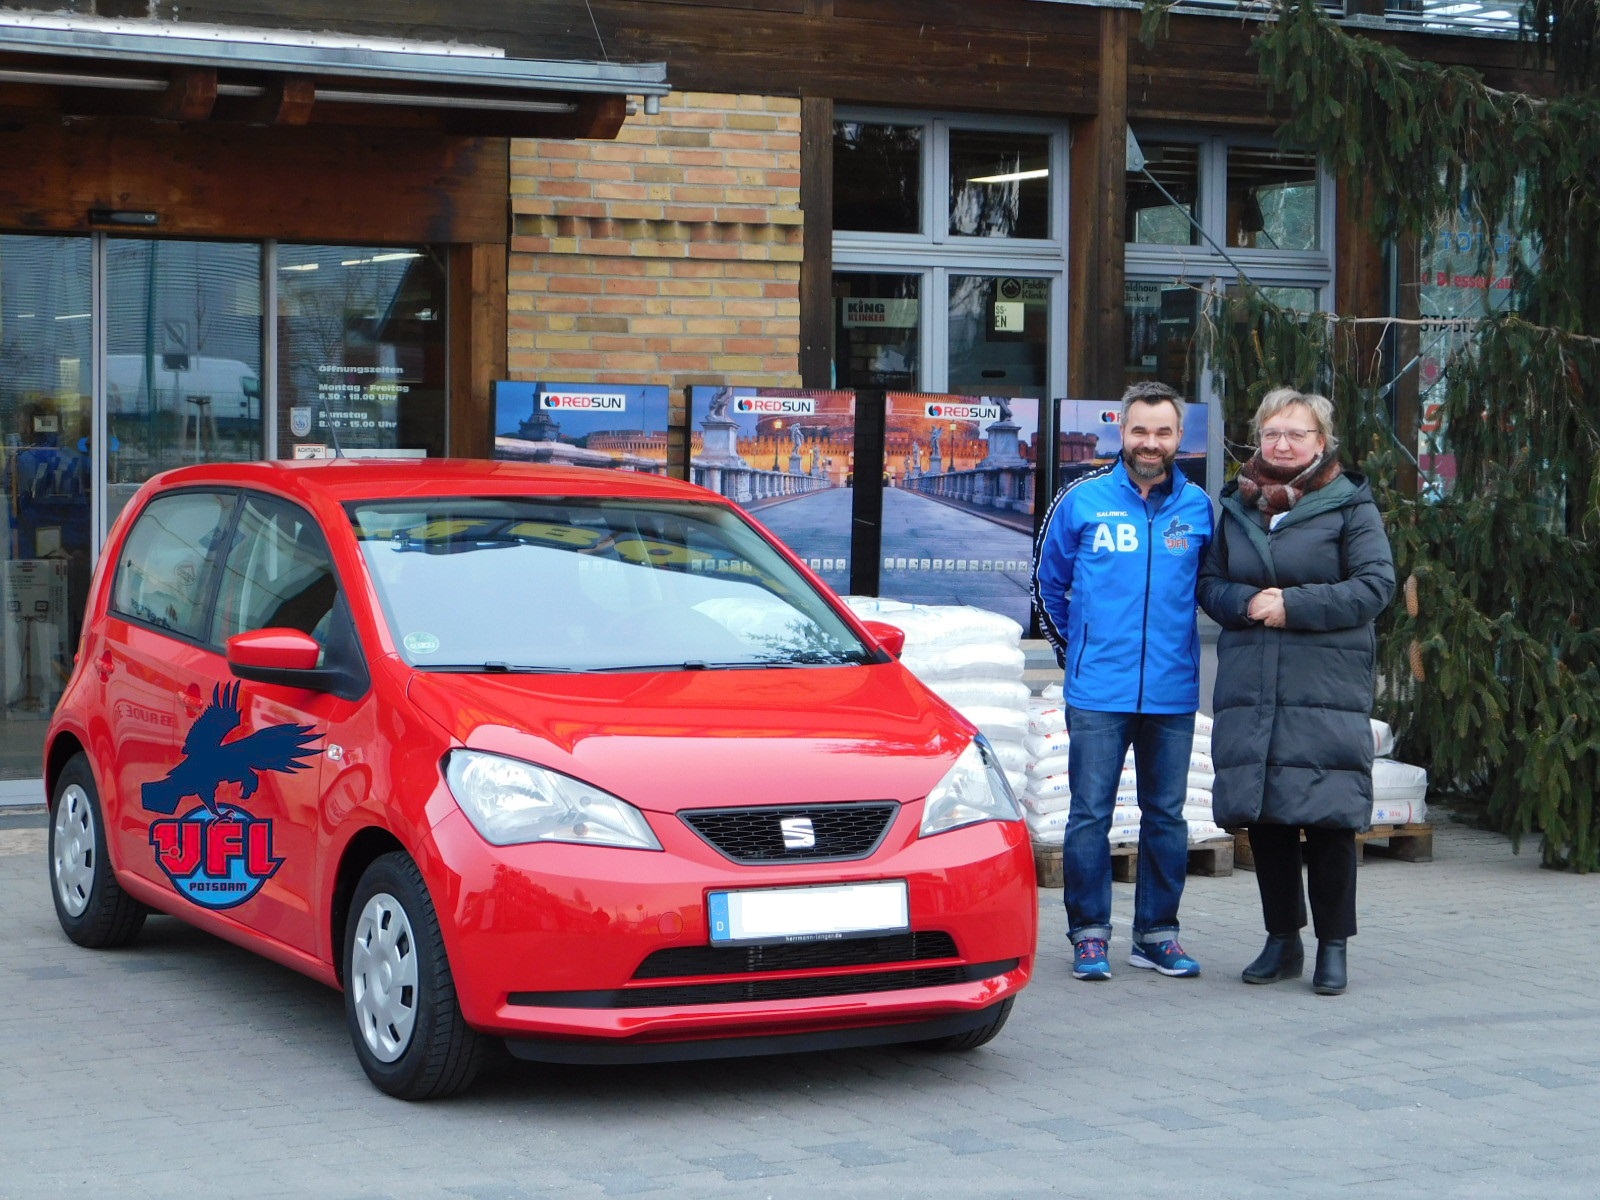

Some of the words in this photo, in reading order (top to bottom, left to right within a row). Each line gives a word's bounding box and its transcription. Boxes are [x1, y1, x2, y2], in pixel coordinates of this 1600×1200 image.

[1124, 284, 1158, 292] eldhaus
[848, 313, 885, 322] KLINKER
[319, 364, 404, 374] Öffnungszeiten
[319, 384, 360, 392] Montag
[369, 384, 410, 393] Freitag
[562, 396, 621, 408] REDSUN
[754, 400, 811, 412] REDSUN
[943, 406, 997, 418] REDSUN
[1092, 523, 1139, 552] AB
[189, 881, 247, 892] POTSDAM
[716, 921, 724, 931] D
